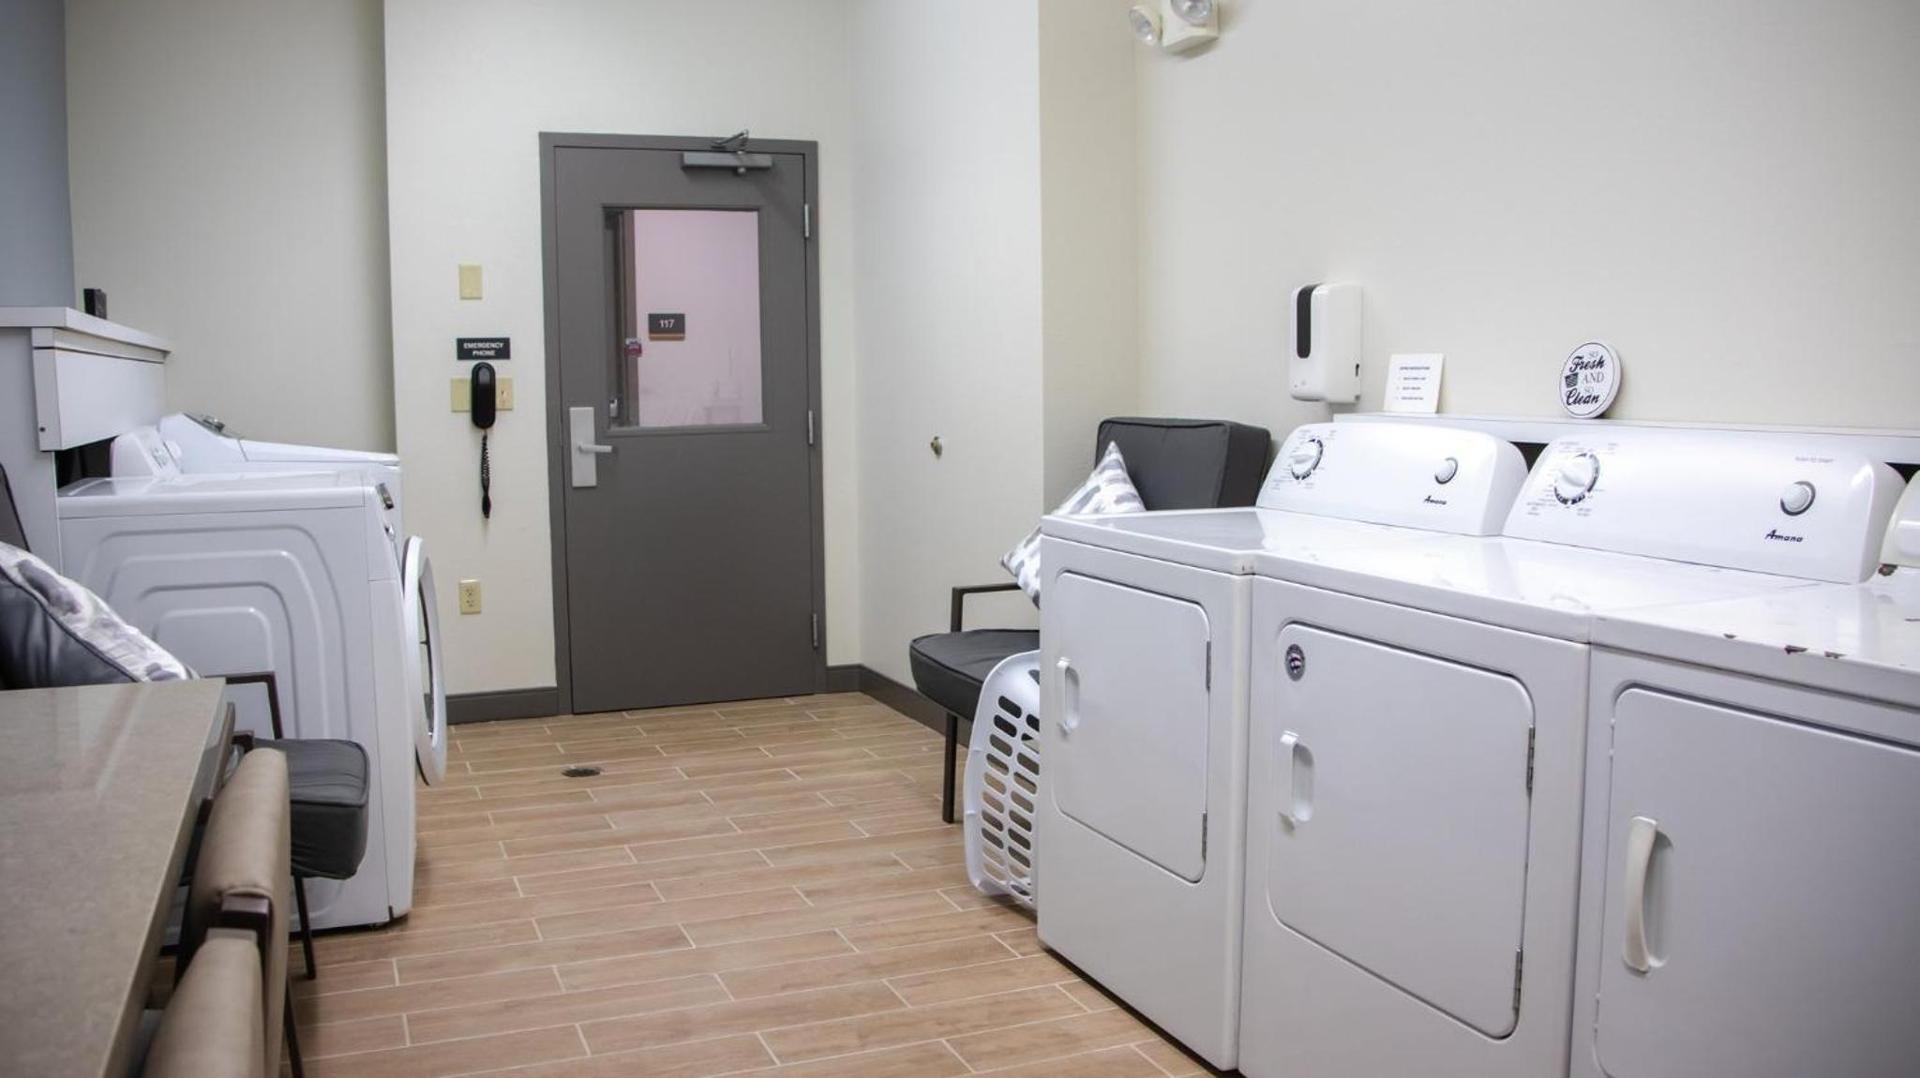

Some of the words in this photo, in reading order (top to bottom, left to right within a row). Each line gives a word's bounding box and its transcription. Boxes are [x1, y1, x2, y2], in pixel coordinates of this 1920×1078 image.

[660, 319, 675, 328] 117
[1569, 355, 1605, 373] Fresh
[1584, 371, 1605, 383] AND
[1566, 387, 1600, 406] Clean
[1764, 529, 1802, 542] Amana
